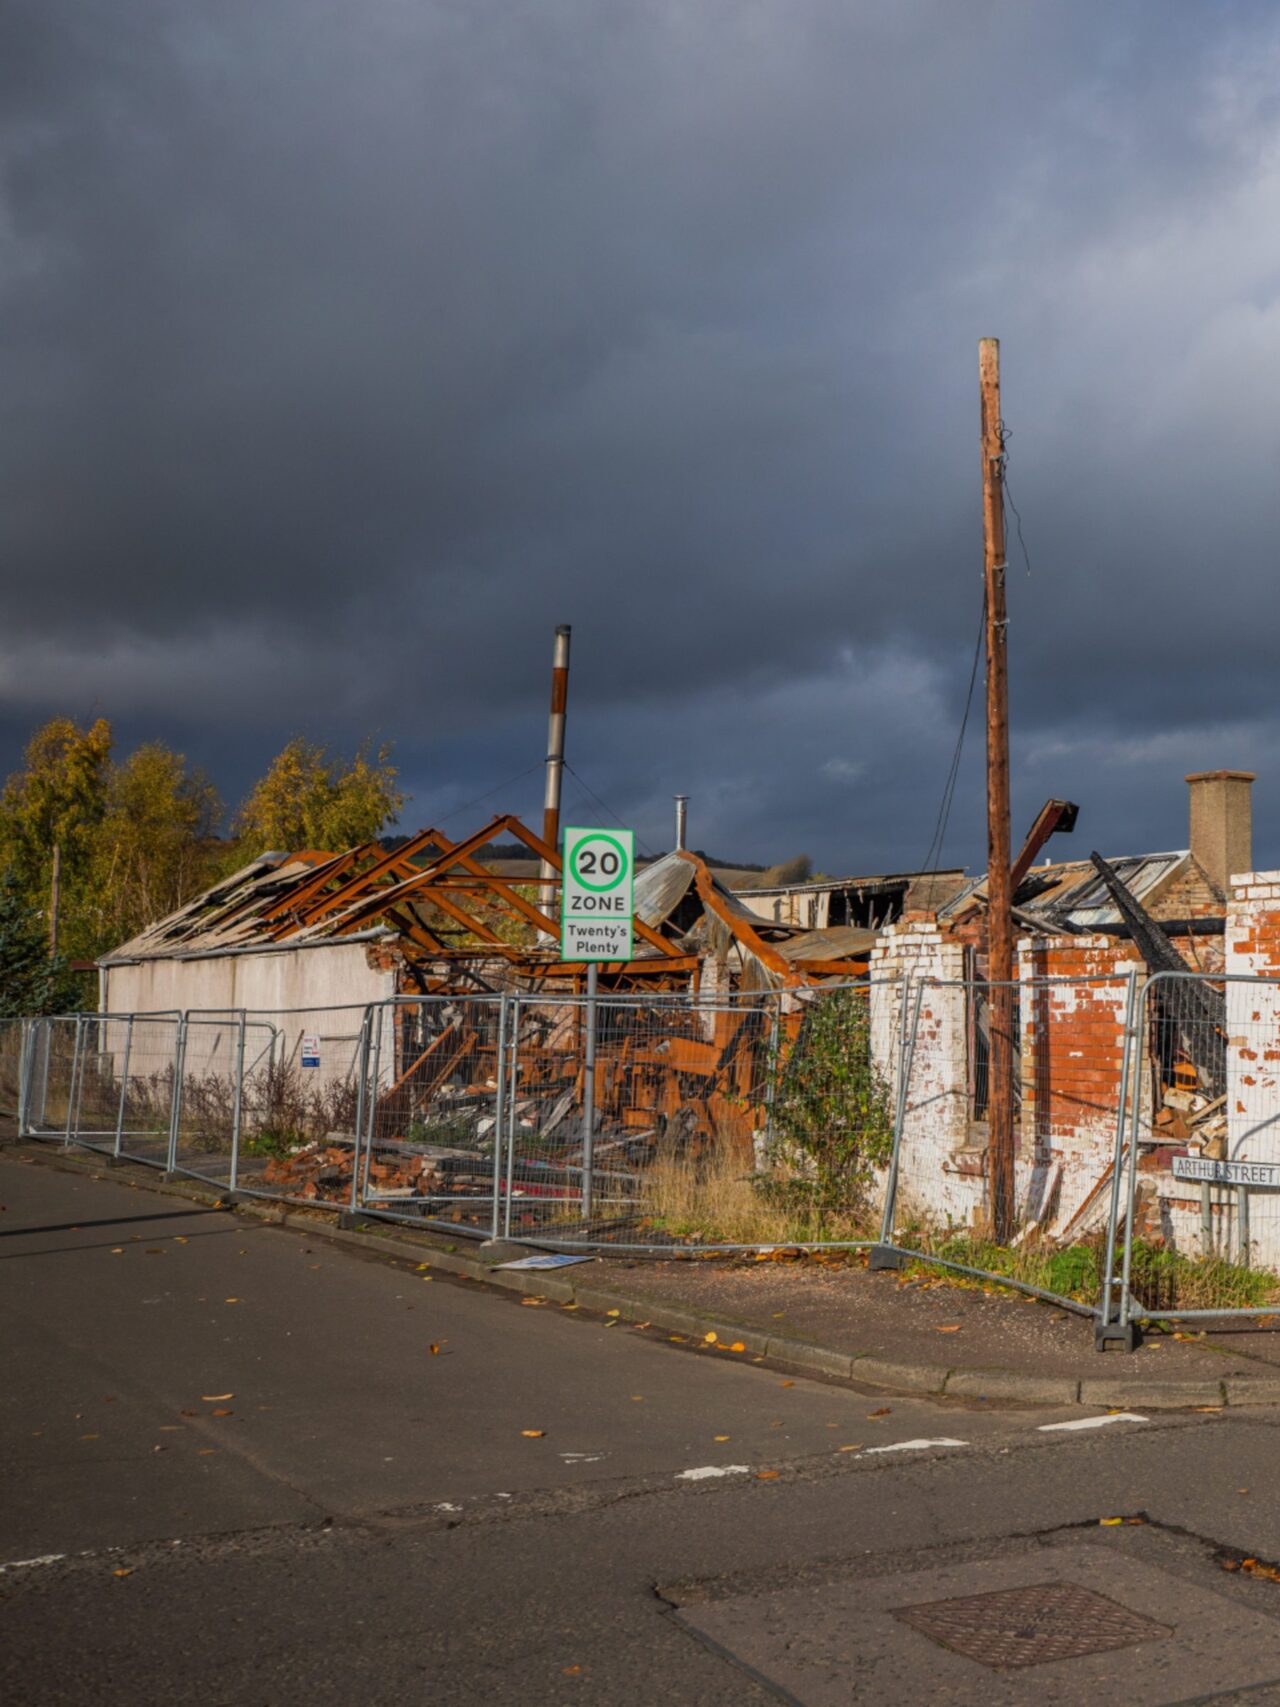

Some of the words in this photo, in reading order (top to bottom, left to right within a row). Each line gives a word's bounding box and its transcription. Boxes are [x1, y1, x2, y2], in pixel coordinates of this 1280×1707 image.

[579, 850, 619, 875] 20
[571, 896, 625, 911] ZONE
[568, 924, 627, 939] Twenty's
[576, 941, 619, 955] Plenty
[1177, 1159, 1224, 1180] ARTHUR
[1225, 1164, 1276, 1183] STREET
